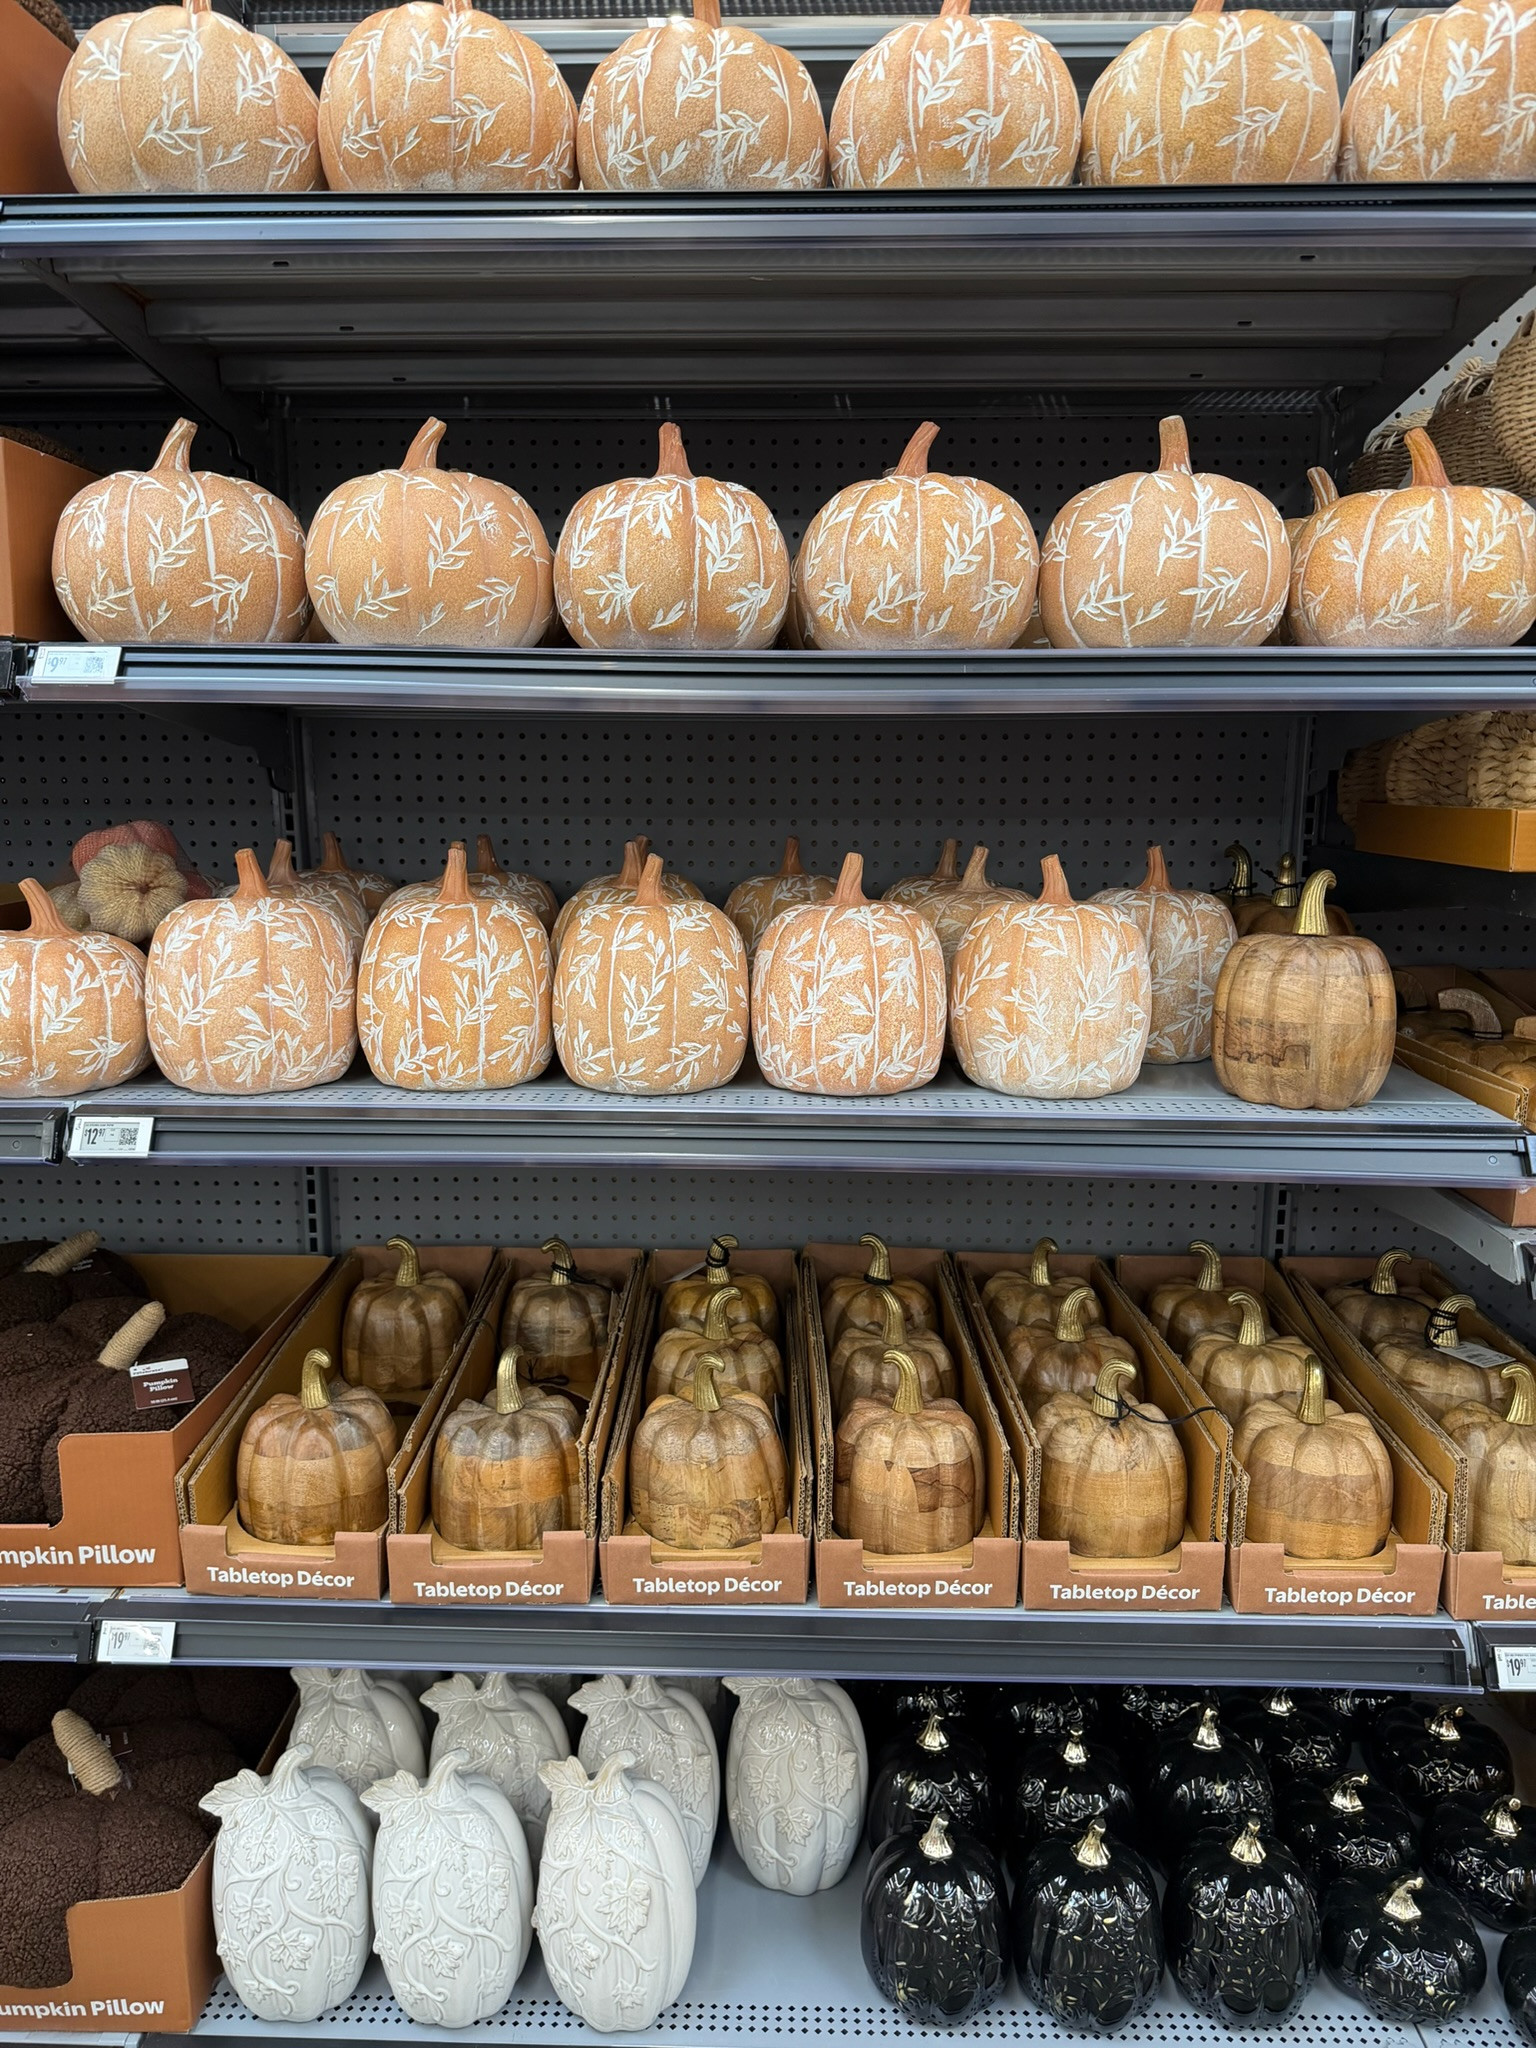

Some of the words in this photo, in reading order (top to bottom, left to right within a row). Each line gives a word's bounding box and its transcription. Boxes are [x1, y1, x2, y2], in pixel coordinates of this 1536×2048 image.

[0, 1545, 74, 1568] mpkin
[79, 1545, 156, 1565] Pillow
[206, 1566, 294, 1588] Tabletop
[297, 1570, 355, 1588] Décor
[632, 1577, 721, 1596] Tabletop
[724, 1576, 783, 1593] Décor
[413, 1581, 503, 1600] Tabletop
[506, 1581, 565, 1597] Décor
[843, 1581, 932, 1599] Tabletop
[934, 1579, 993, 1596] Décor
[1049, 1584, 1138, 1603] Tabletop
[1141, 1583, 1201, 1600] Décor
[1264, 1587, 1354, 1607] Tabletop
[1356, 1586, 1417, 1604] Décor
[1481, 1594, 1536, 1610] Table
[0, 2001, 87, 2019] umpkin
[91, 1999, 165, 2017] Pillow
